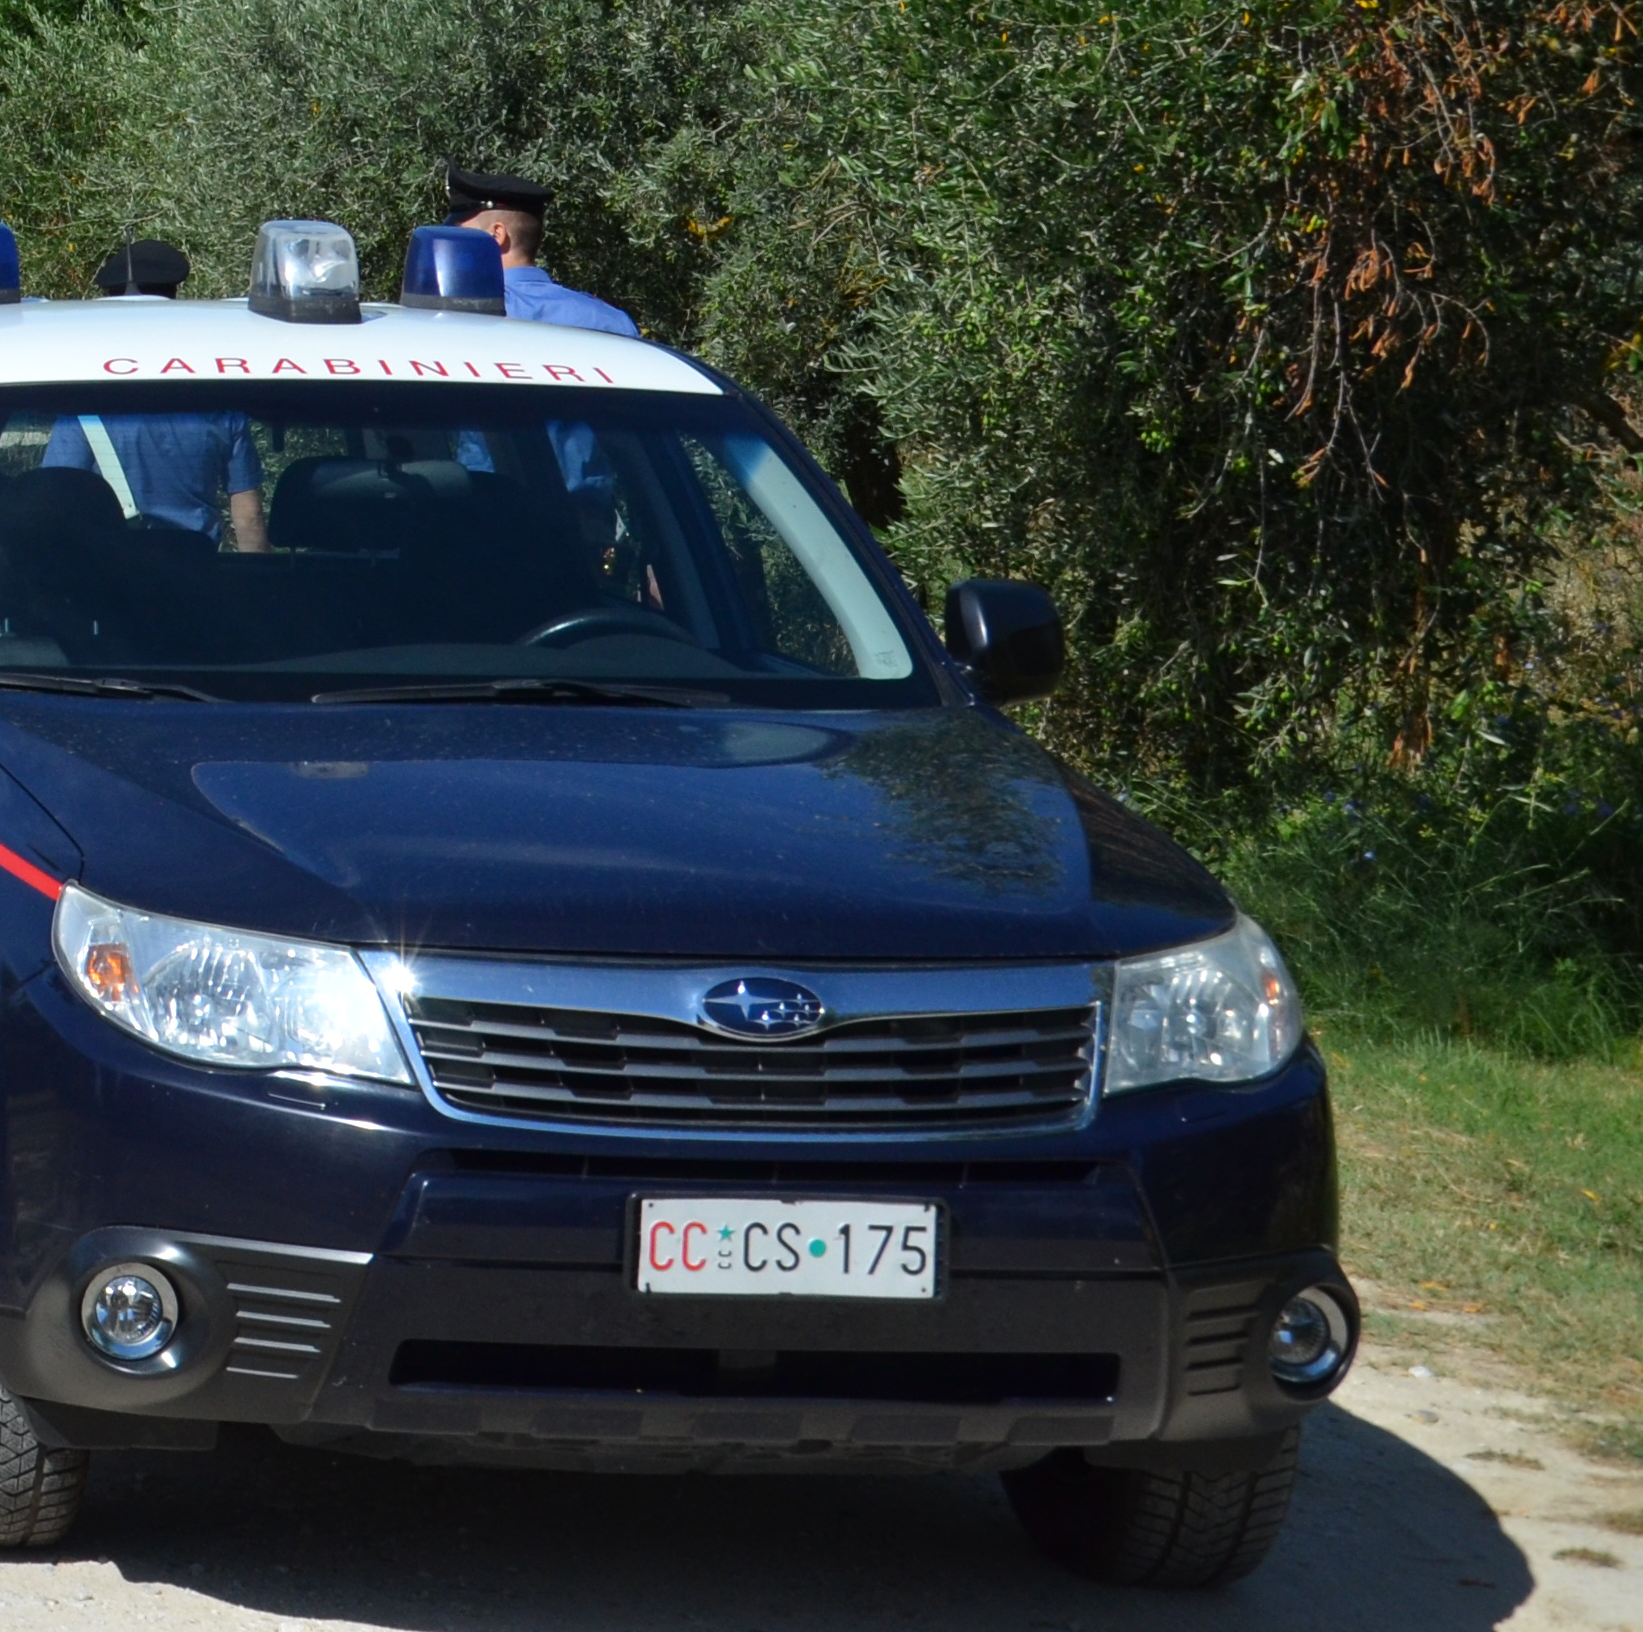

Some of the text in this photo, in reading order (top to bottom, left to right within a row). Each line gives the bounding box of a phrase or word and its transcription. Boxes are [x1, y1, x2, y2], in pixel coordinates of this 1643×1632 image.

[102, 357, 615, 384] CARABINIERI
[649, 1221, 707, 1271] CC
[743, 1222, 801, 1272] CS
[838, 1223, 927, 1275] 175
